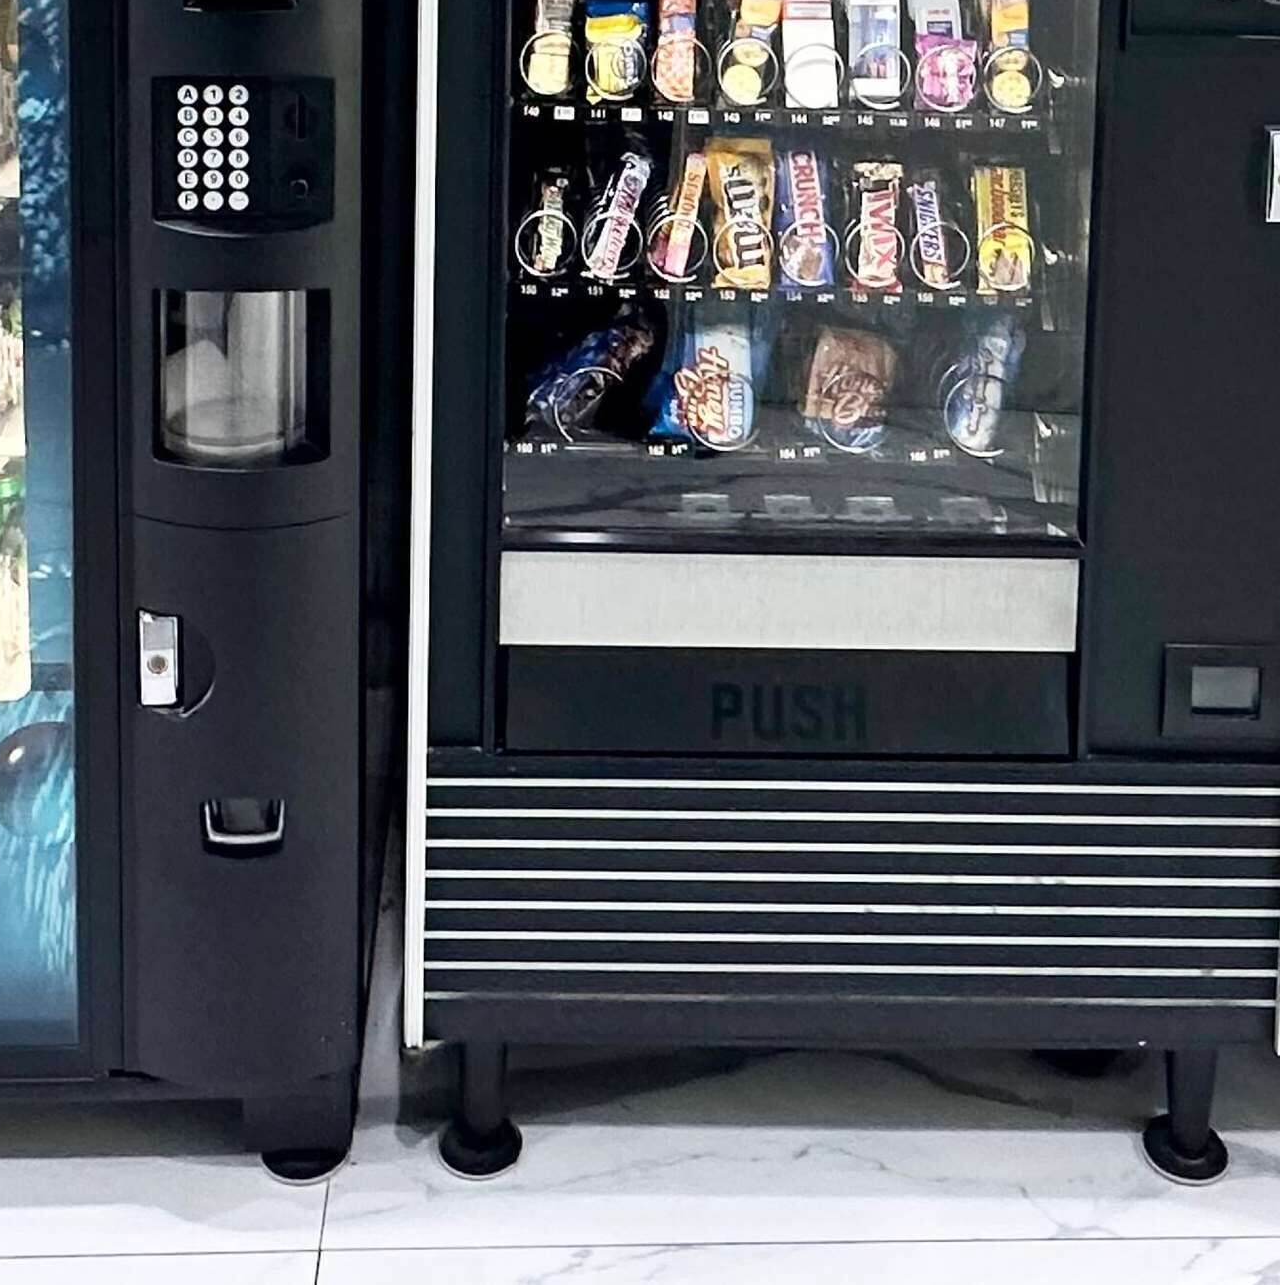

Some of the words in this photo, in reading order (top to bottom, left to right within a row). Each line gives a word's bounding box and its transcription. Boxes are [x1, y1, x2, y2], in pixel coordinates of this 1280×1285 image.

[183, 88, 193, 100] A
[206, 89, 216, 99] 1
[232, 89, 243, 100] 2
[184, 109, 193, 121] B
[210, 110, 217, 121] 3
[235, 110, 242, 120] 4
[183, 130, 193, 142] C
[210, 131, 217, 142] 5
[235, 131, 243, 142] 6
[183, 151, 193, 163] D
[211, 152, 217, 162] 7
[236, 153, 243, 163] 8
[185, 173, 193, 184] E
[210, 173, 218, 184] 9
[235, 173, 243, 184] 0
[185, 193, 193, 205] F
[790, 150, 822, 238] CRUNCH
[867, 189, 897, 267] TWIX
[727, 381, 744, 439] JUMBO
[712, 682, 867, 741] PUSH
